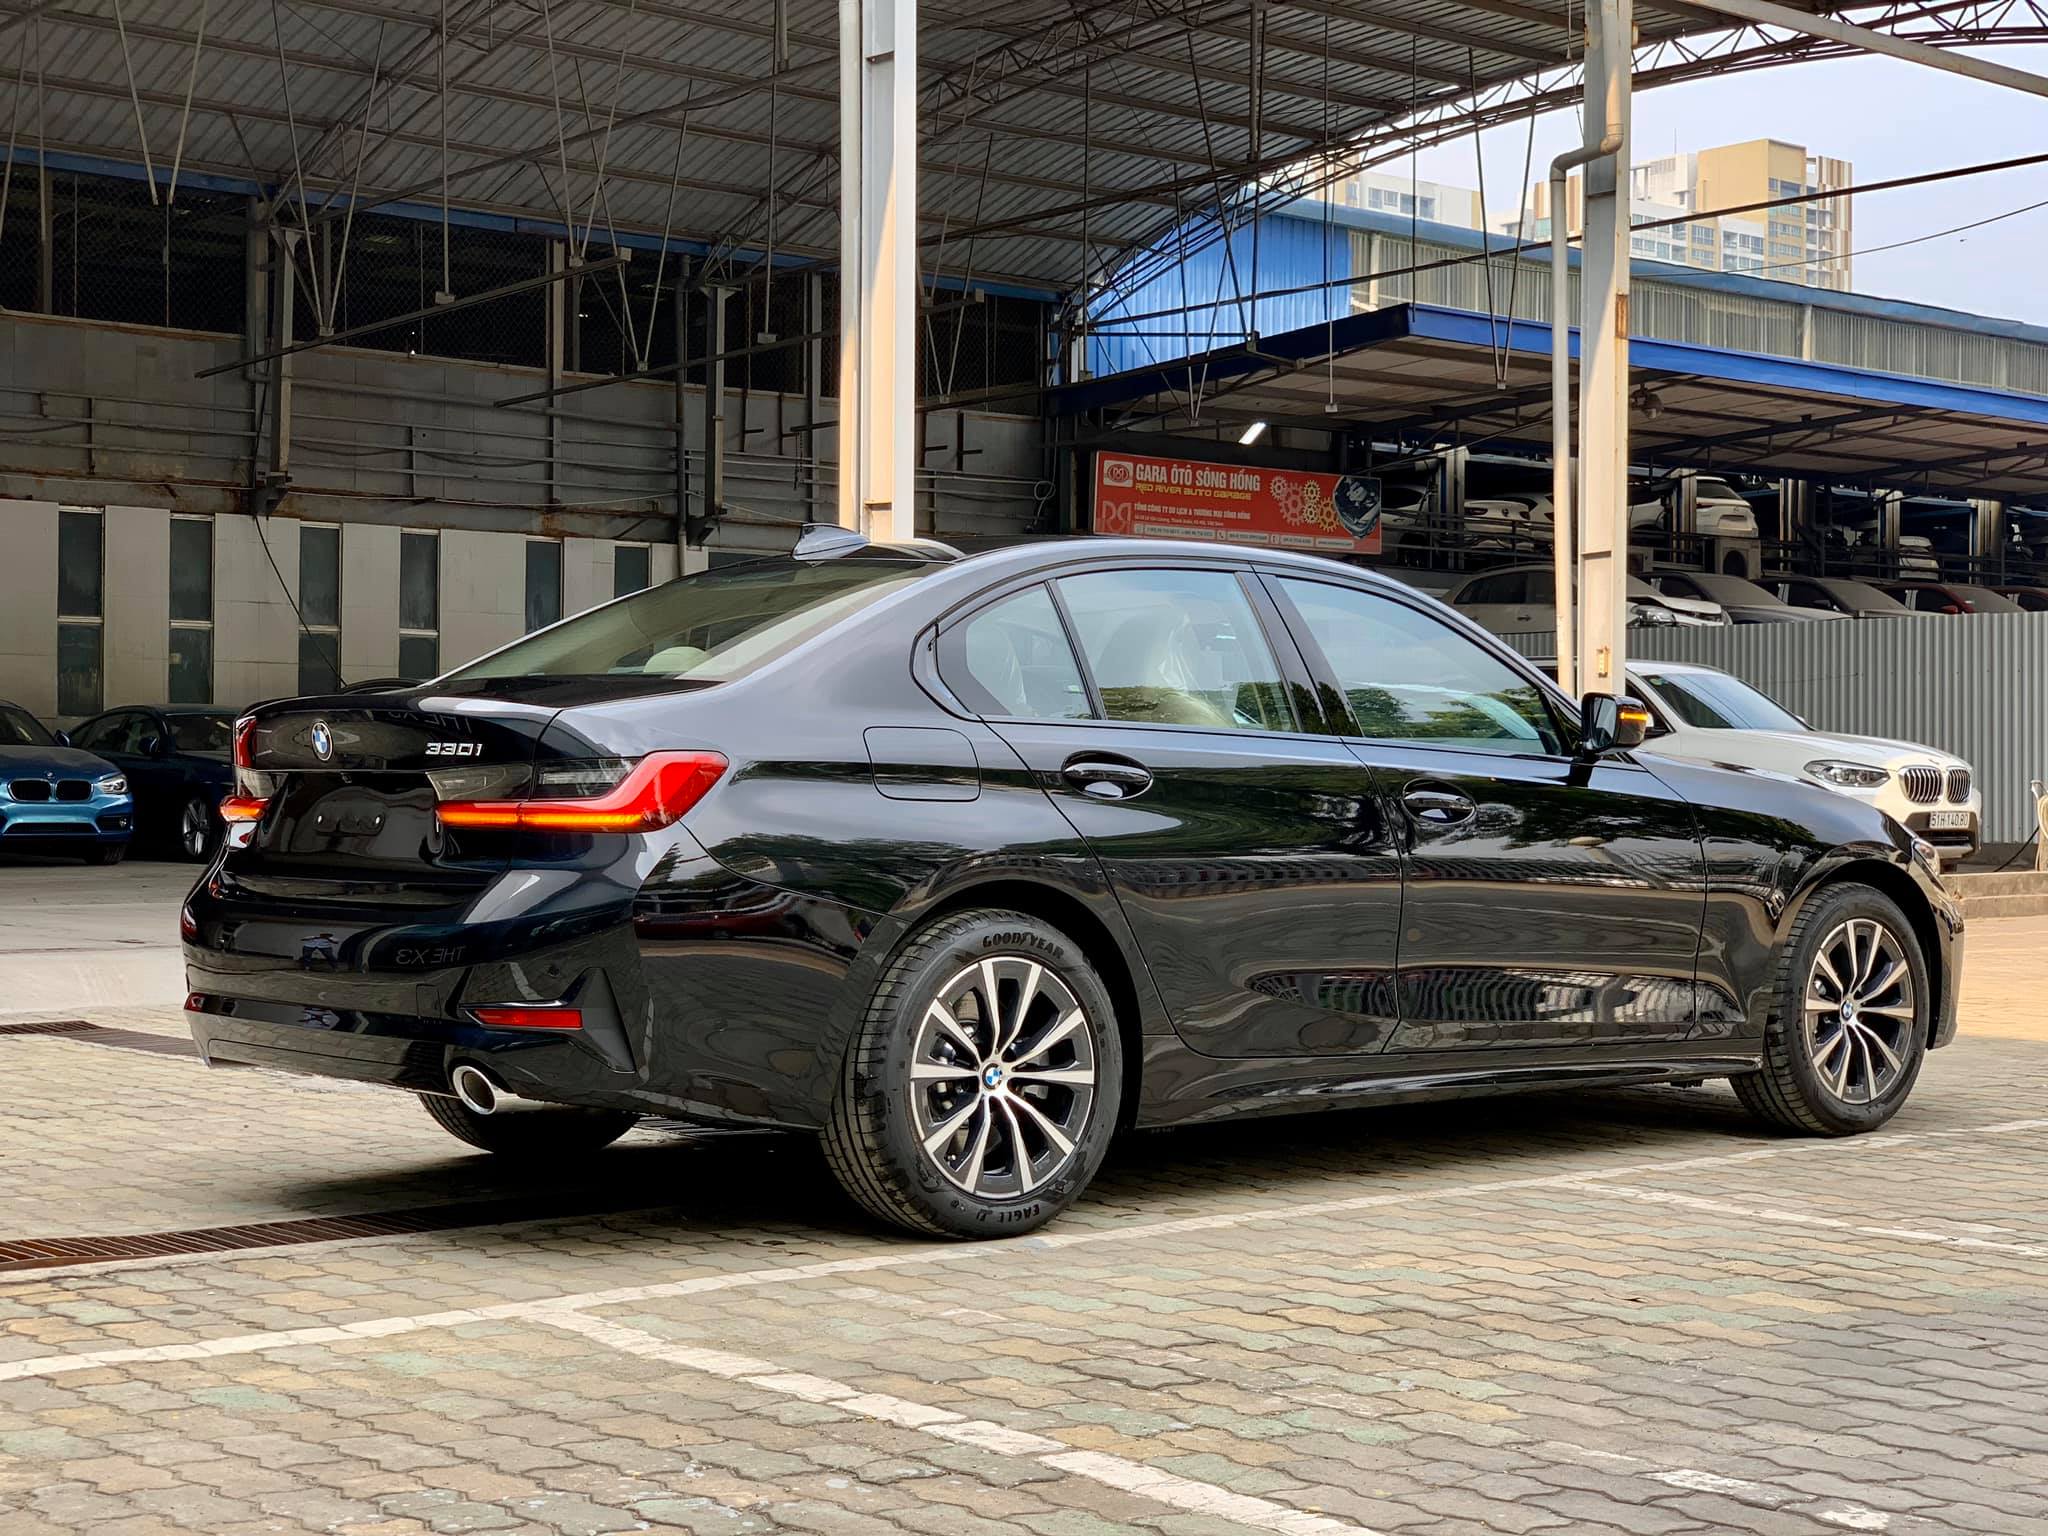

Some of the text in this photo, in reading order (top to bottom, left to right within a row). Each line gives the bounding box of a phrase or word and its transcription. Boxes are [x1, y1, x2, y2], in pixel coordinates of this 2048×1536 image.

[1135, 463, 1168, 483] GARA
[1170, 464, 1192, 486] ÔTÔ
[1195, 466, 1227, 489] SÔNG
[1155, 483, 1182, 493] RIVER
[982, 931, 1065, 960] GOODYEAR
